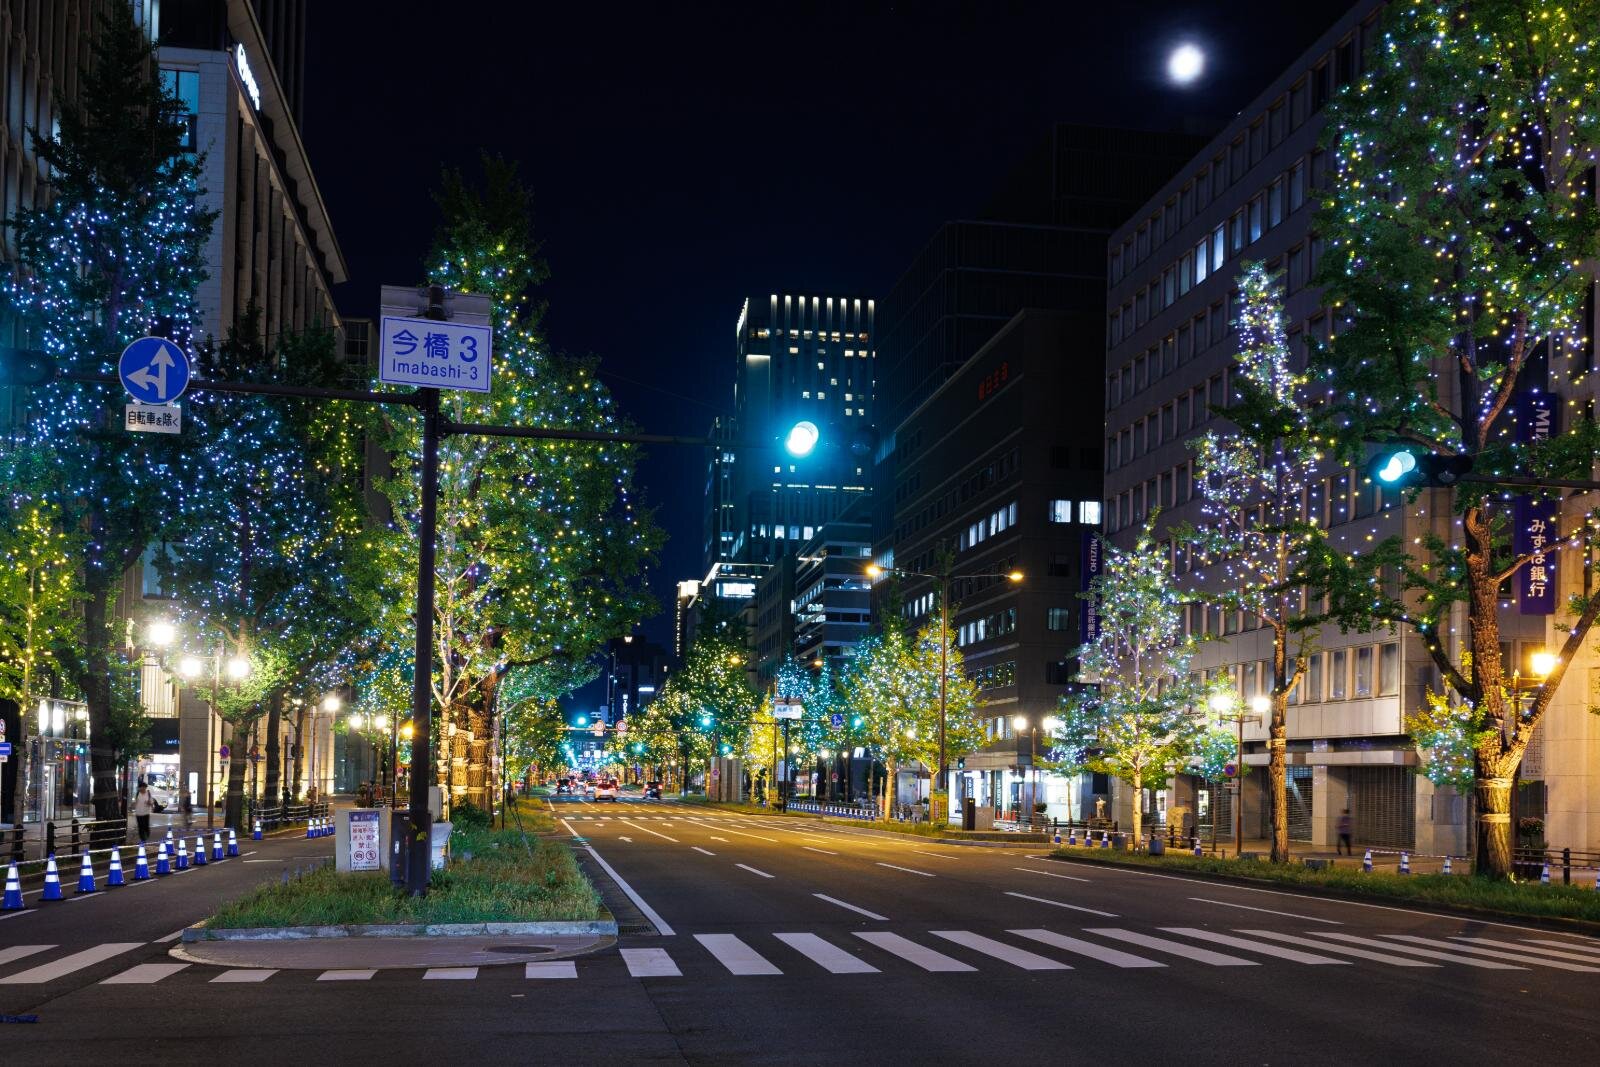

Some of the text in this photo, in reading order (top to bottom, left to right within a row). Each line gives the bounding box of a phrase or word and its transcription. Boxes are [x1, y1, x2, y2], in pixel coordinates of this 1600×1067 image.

[392, 329, 478, 363] 今橋 3
[392, 358, 478, 381] Imabashi-3
[128, 410, 178, 427] 自転車を除く
[1090, 538, 1098, 573] MIZUHO
[1530, 519, 1546, 597] みずほ銀行
